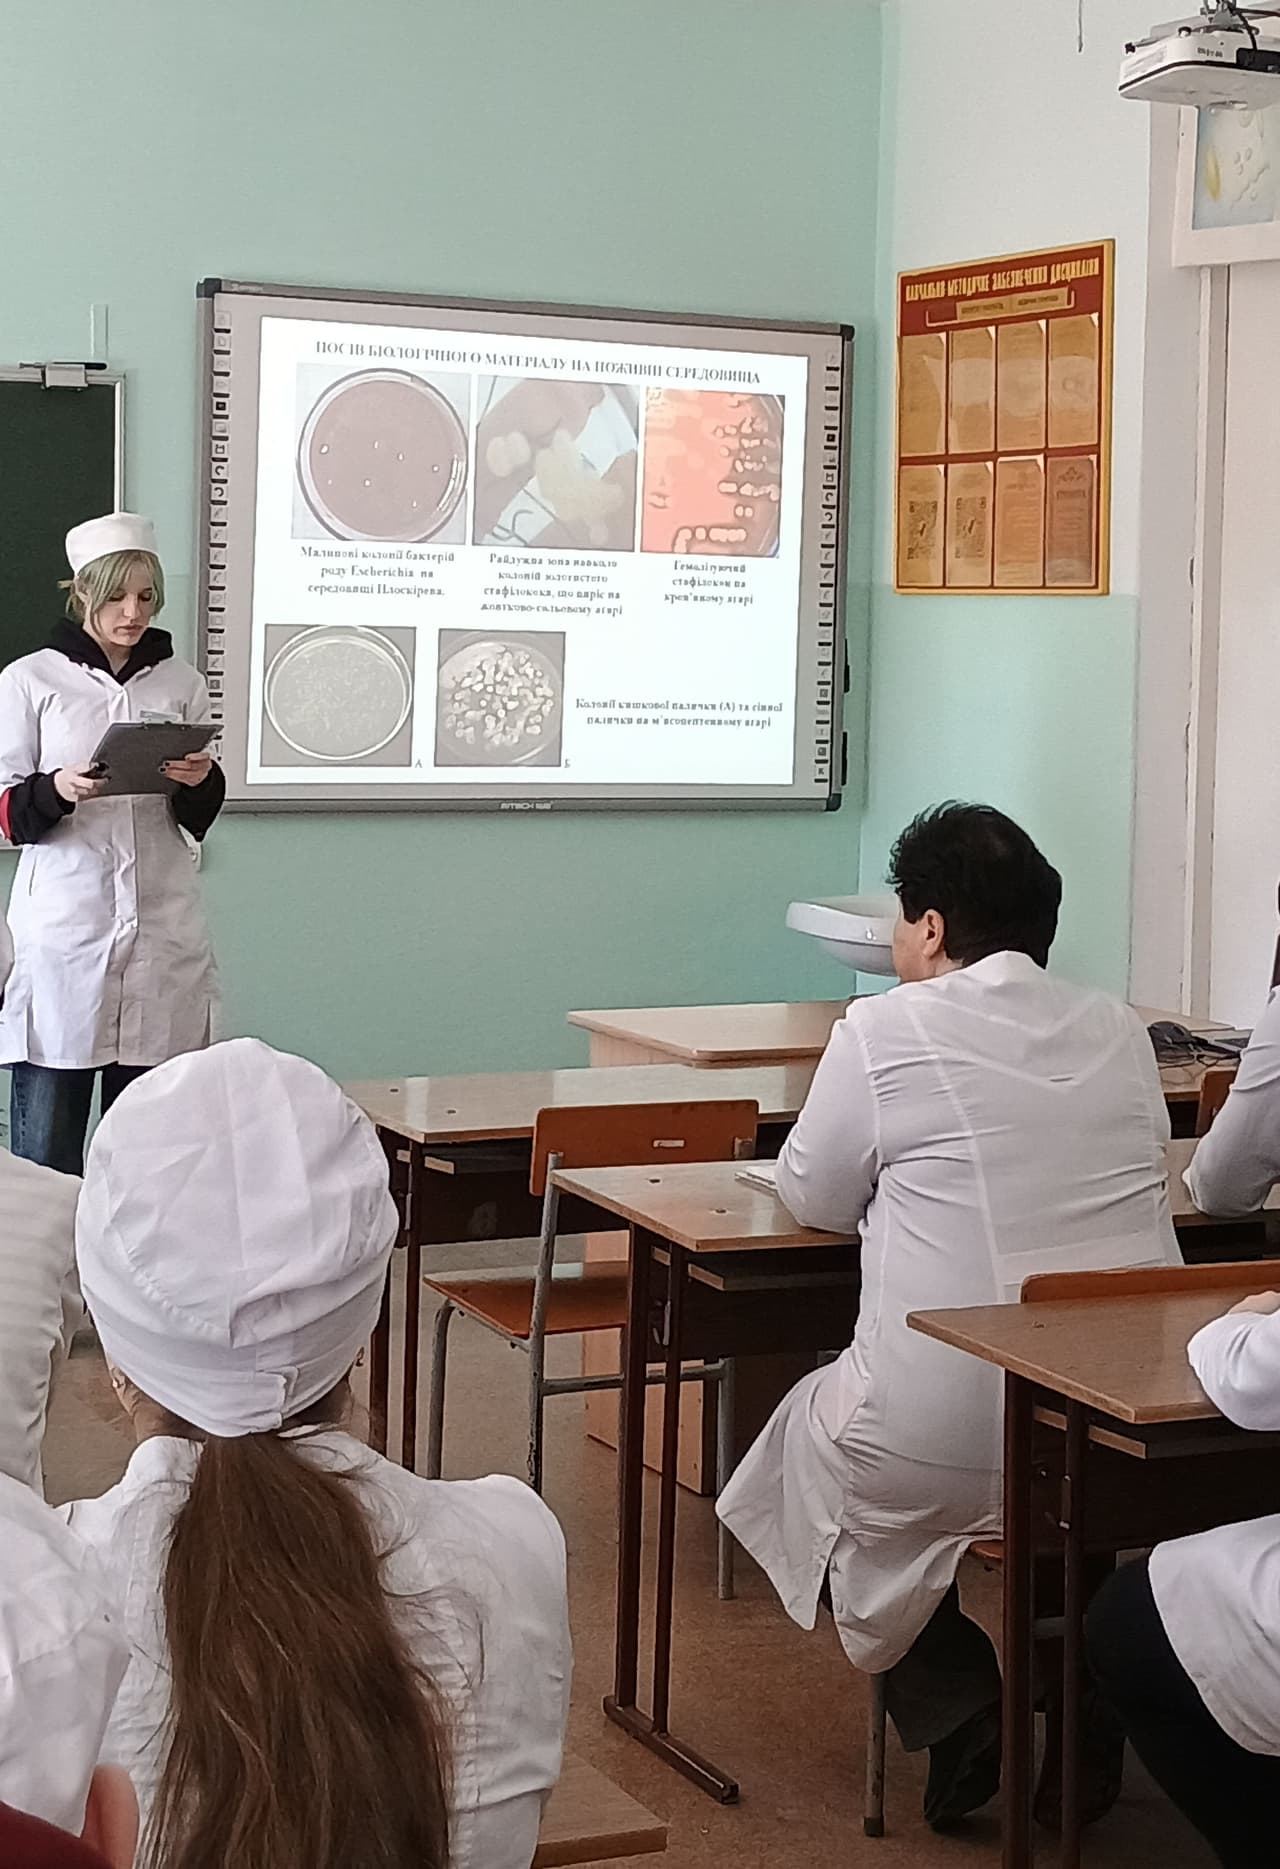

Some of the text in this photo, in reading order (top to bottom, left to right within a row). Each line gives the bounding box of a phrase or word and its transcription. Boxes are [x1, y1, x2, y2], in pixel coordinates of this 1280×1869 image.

[316, 341, 761, 384] ПОСІВ БІОЛОГІЧНОГО МАТЕРІАЛУ НА ПОЖИВНІ СЕРЕДОВИЩА
[302, 546, 358, 558] Малинові
[406, 551, 454, 564] бактерій
[321, 567, 346, 578] роду
[351, 565, 414, 578] Escherichia
[308, 584, 373, 595] середовищі
